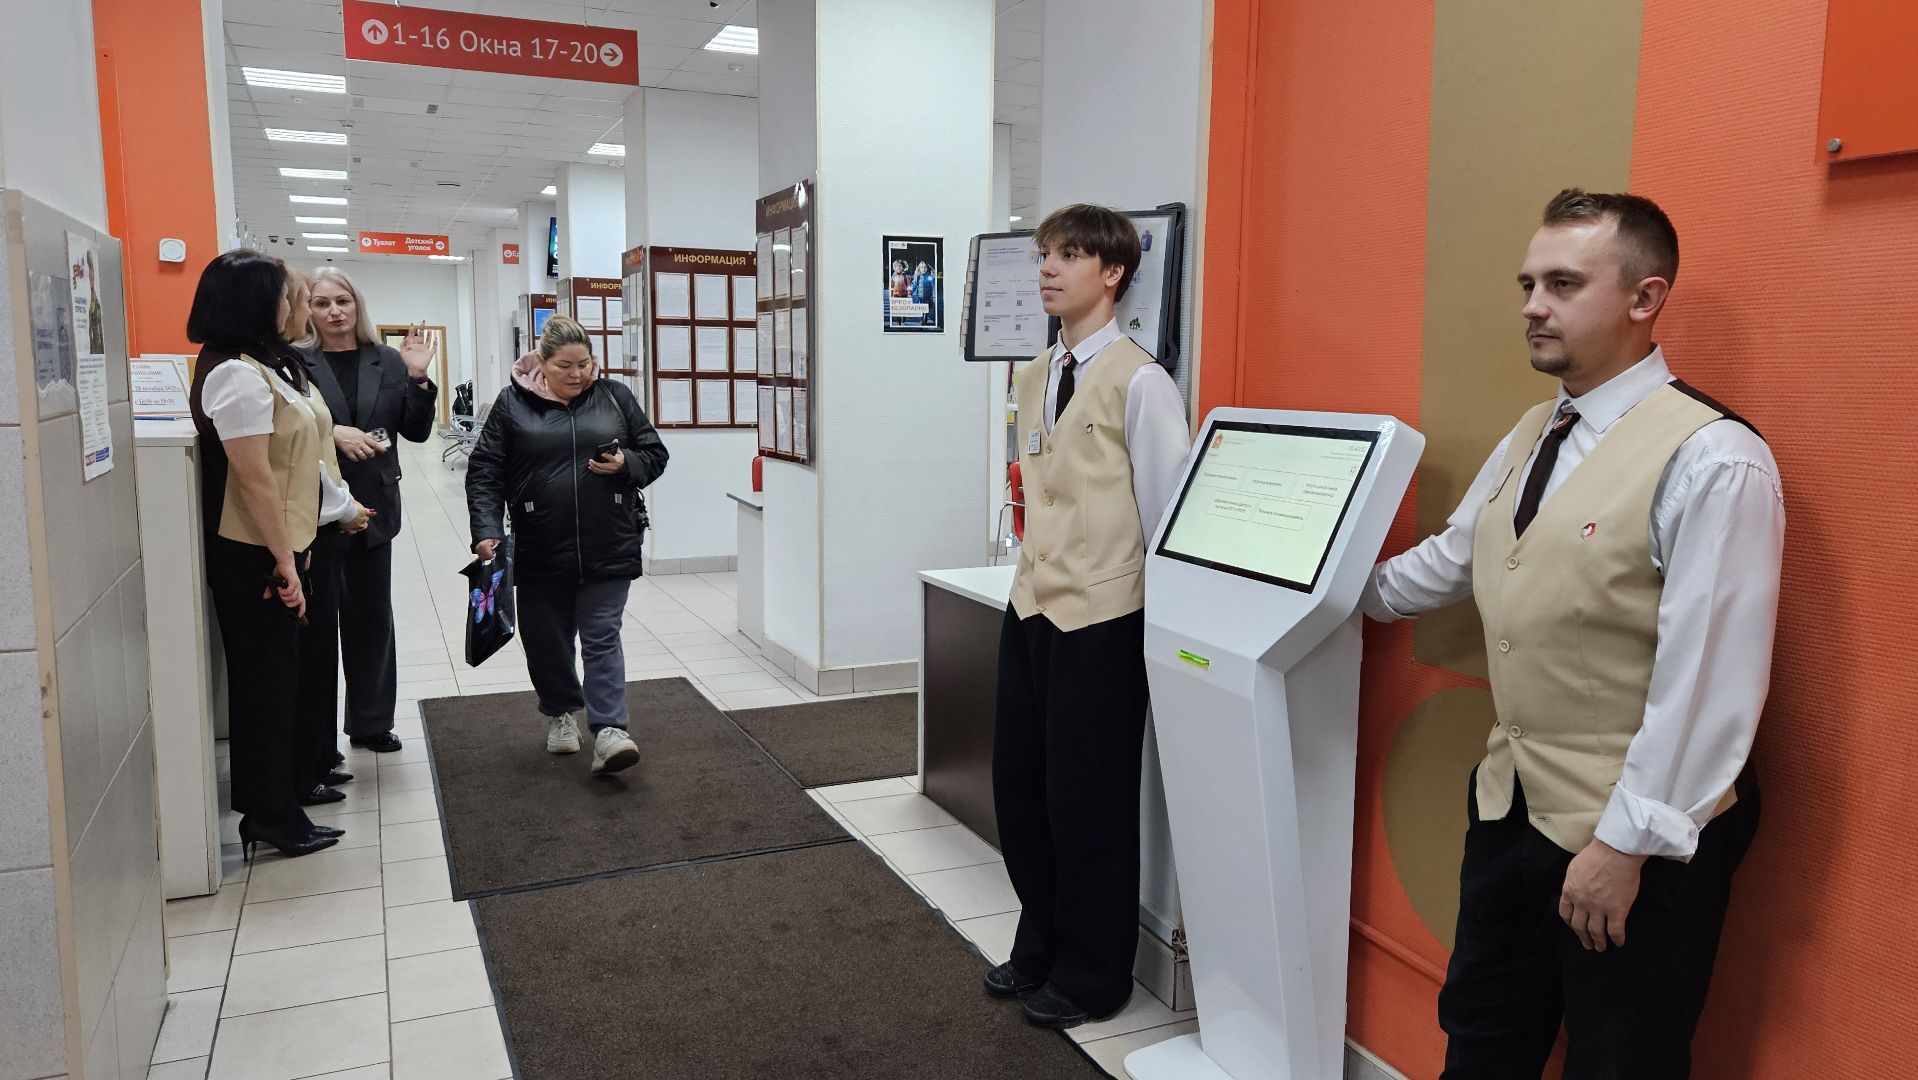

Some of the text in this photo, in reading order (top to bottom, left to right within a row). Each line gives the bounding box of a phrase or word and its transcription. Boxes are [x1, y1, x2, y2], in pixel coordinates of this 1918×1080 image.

[393, 22, 598, 64] 1-16 Окна 17-20
[372, 238, 396, 247] Туалет
[405, 237, 434, 245] Детский
[674, 253, 746, 266] ИНФОРМАЦИЯ
